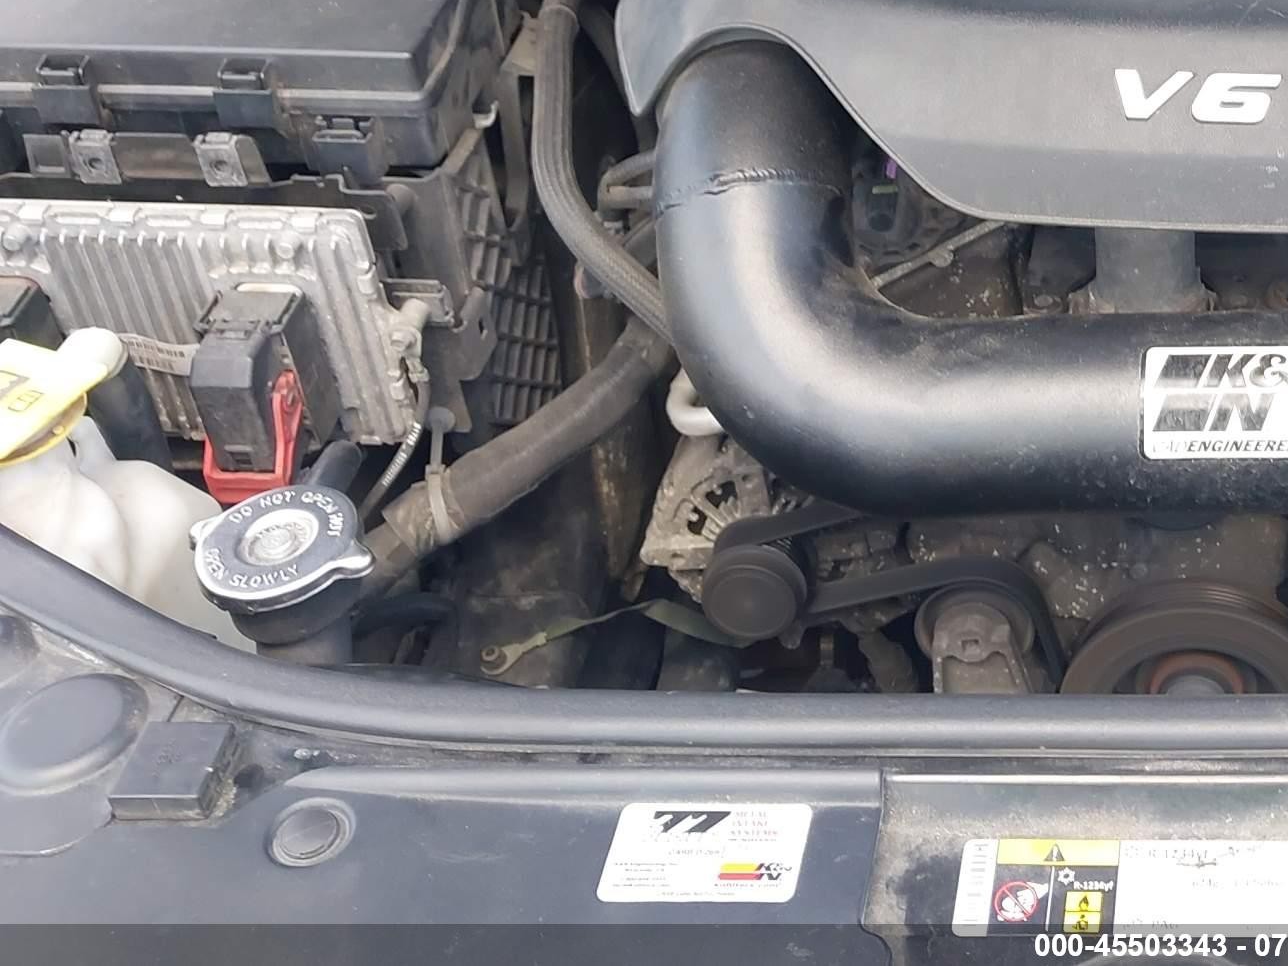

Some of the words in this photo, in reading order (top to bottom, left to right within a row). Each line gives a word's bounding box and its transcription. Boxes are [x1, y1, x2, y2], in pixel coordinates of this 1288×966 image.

[1113, 68, 1282, 124] V6
[228, 505, 253, 524] DO
[259, 491, 296, 508] NOT
[301, 491, 338, 514] OPEN
[1073, 880, 1114, 892] R-1234yf
